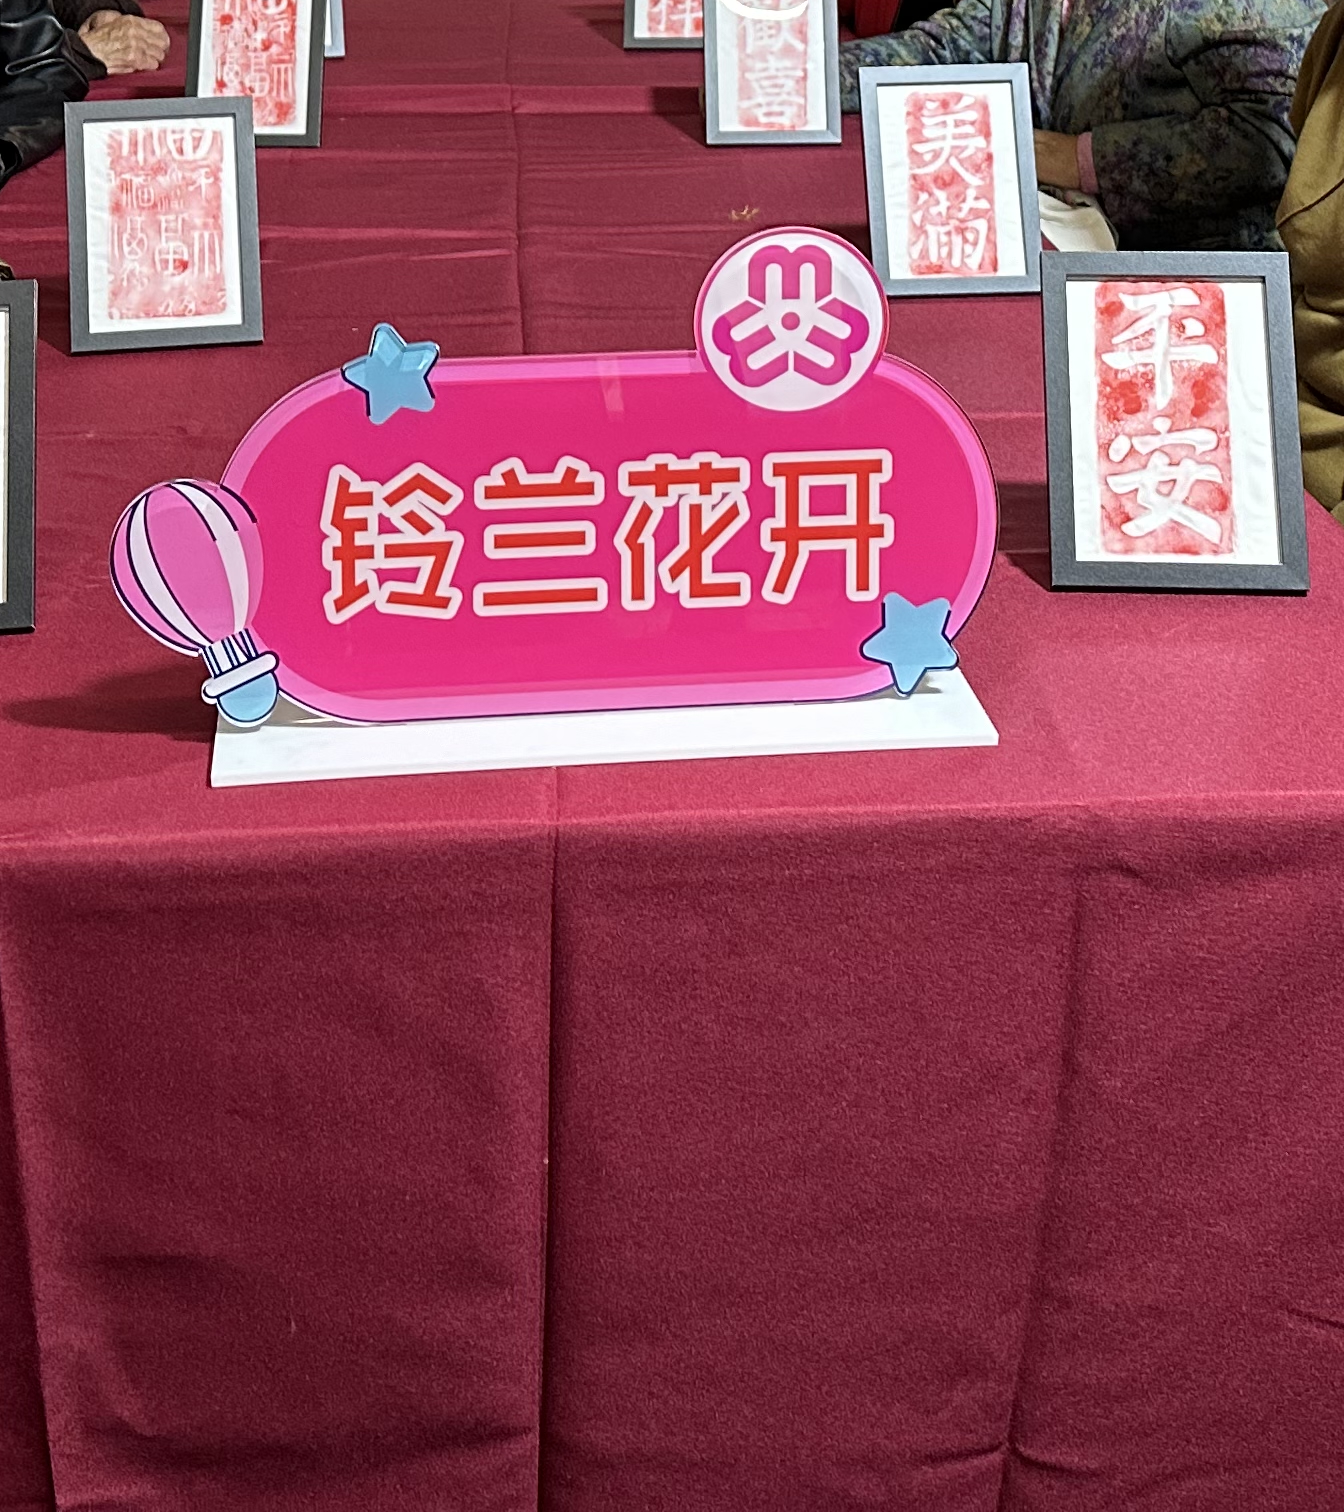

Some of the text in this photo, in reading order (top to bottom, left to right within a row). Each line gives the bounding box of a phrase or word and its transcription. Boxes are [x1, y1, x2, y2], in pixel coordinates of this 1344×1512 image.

[1102, 287, 1223, 545] 平安
[323, 451, 892, 621] 铃兰花开
